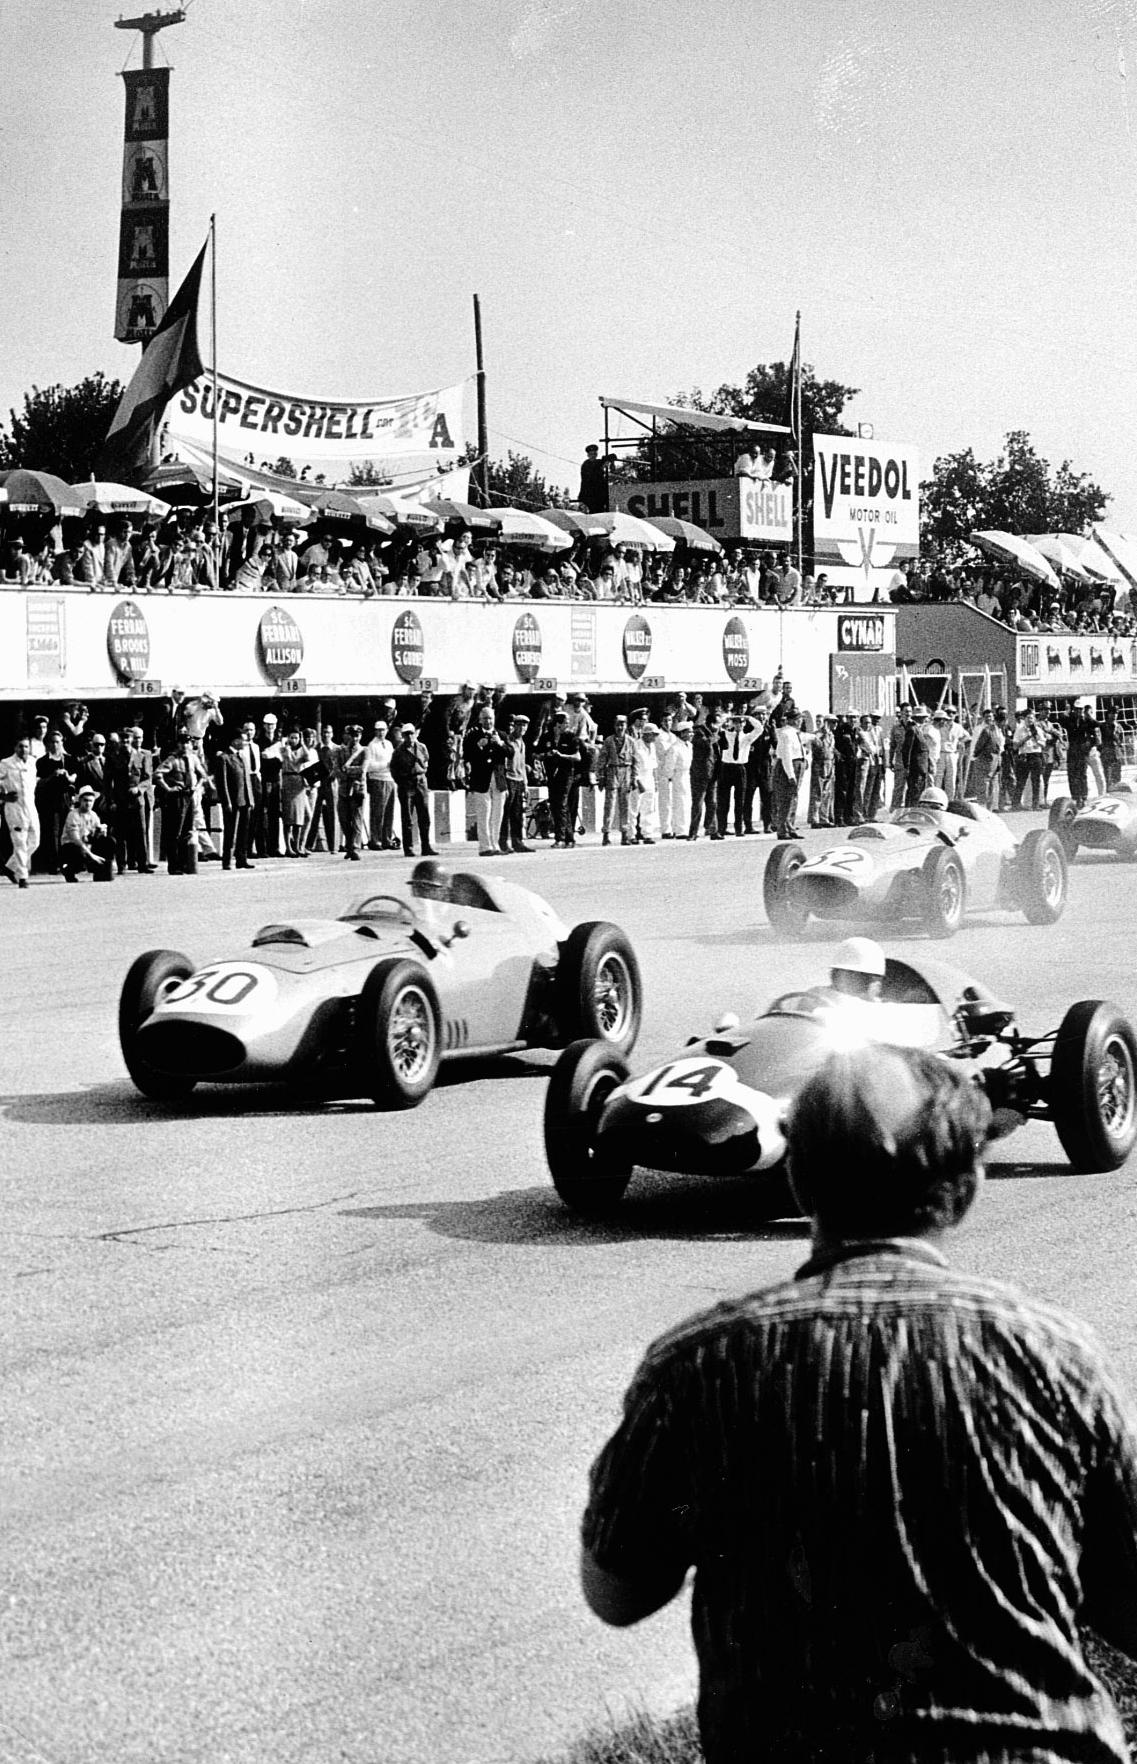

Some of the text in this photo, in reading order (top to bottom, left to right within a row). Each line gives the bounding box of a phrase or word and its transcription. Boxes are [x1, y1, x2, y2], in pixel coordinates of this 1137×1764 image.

[180, 382, 374, 440] SUPERSHELL
[818, 451, 912, 519] VEEDOL
[627, 489, 725, 529] SHELL
[746, 490, 789, 528] SHELL
[849, 508, 898, 524] MOTOR OIL
[261, 625, 301, 643] FERRARI
[841, 619, 884, 646] CYNAR
[114, 638, 149, 653] BROOKS
[265, 647, 302, 664] ALLISON
[727, 653, 748, 668] MOSS
[131, 657, 149, 672] HILL
[140, 682, 153, 693] 16
[286, 681, 299, 691] 18
[418, 680, 432, 690] 19
[539, 680, 553, 689] 20
[646, 678, 659, 688] 21
[743, 679, 758, 688] 22
[802, 850, 865, 873] 32
[165, 970, 258, 1005] 30
[639, 1065, 724, 1098] 14
